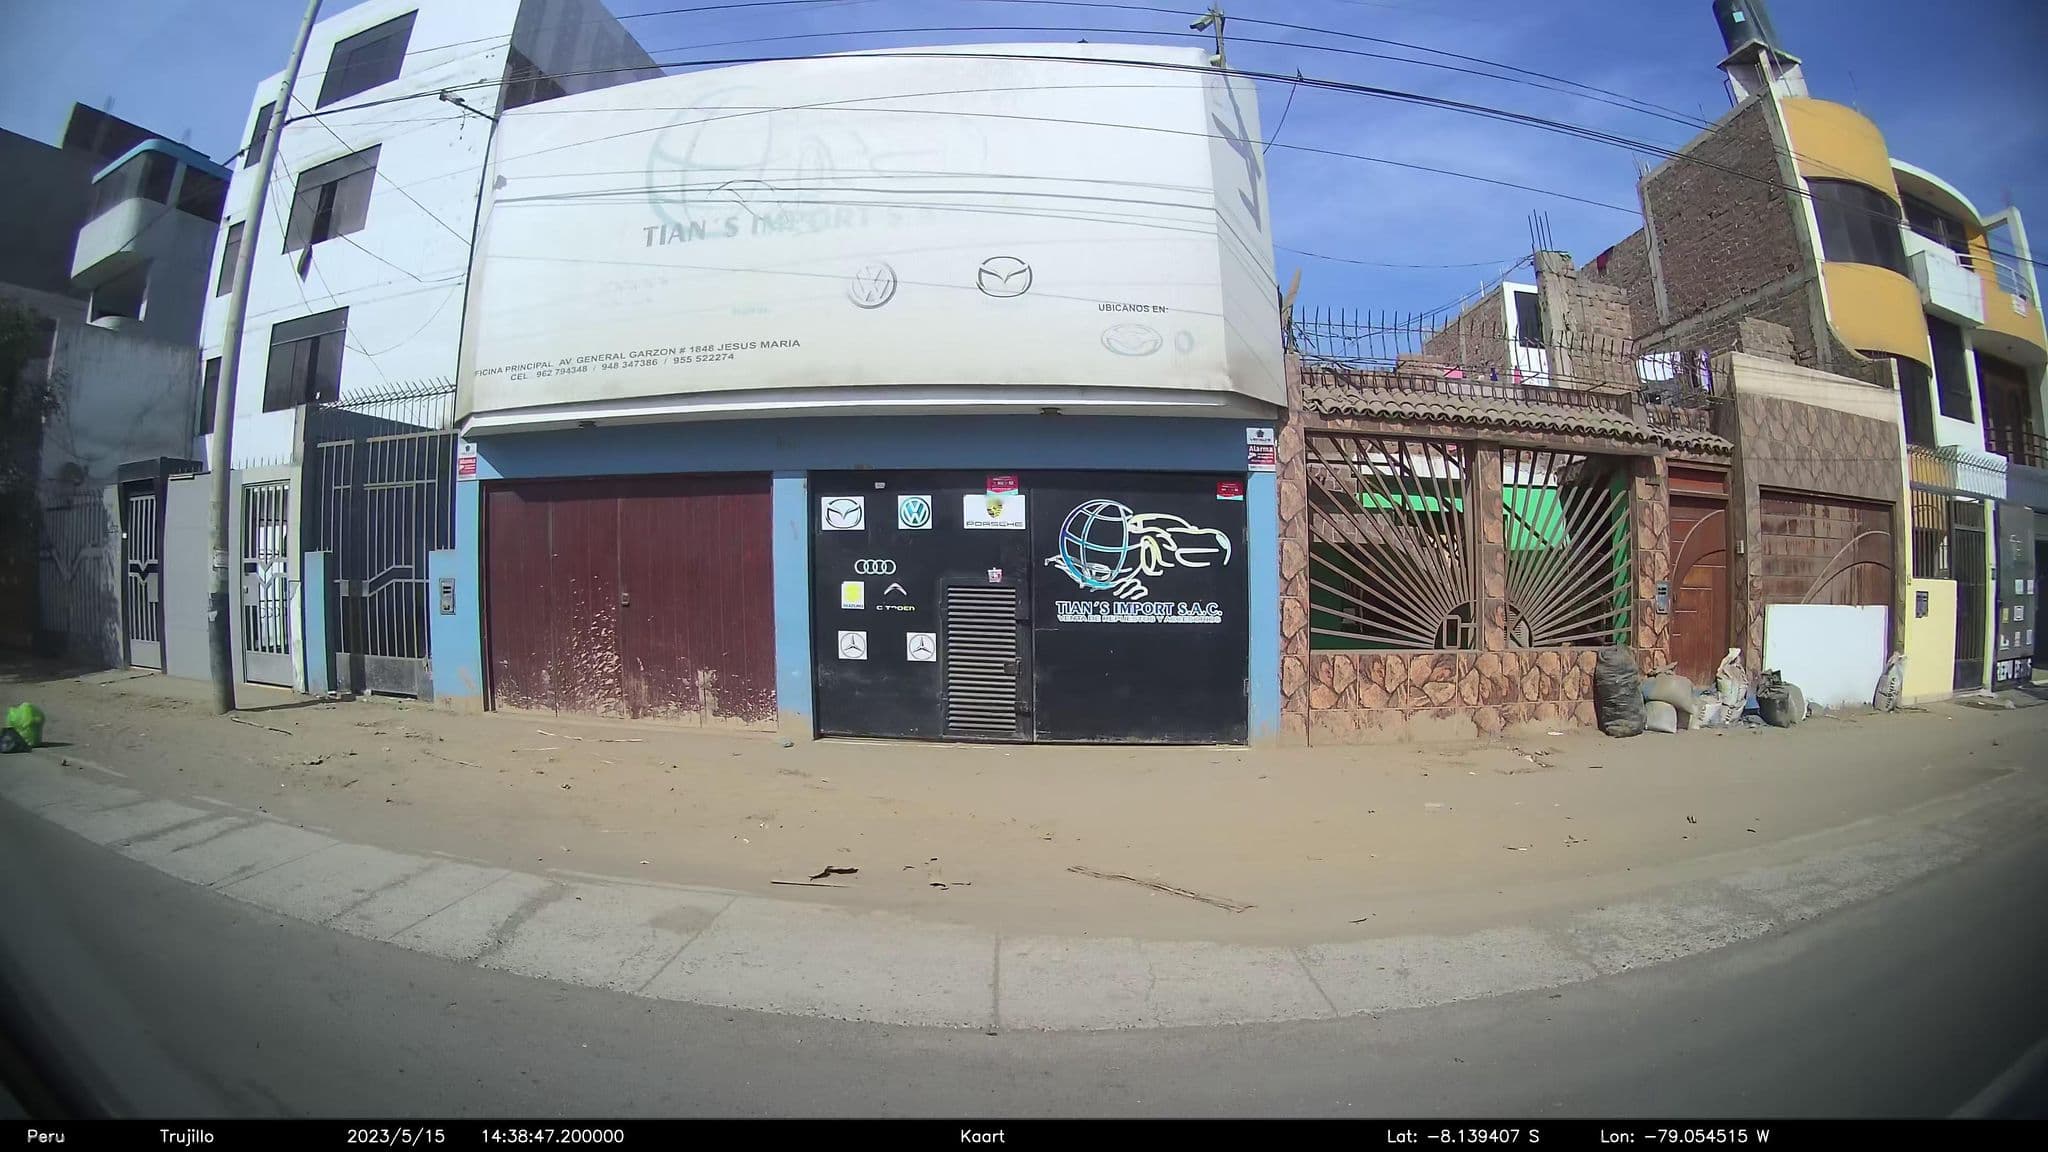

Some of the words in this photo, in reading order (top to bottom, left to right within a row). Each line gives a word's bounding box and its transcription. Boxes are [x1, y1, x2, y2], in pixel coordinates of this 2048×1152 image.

[1098, 303, 1150, 313] UBICANOS
[474, 366, 503, 377] FICINA
[505, 360, 552, 373] PRINCIPAL
[576, 352, 626, 364] GENERAL
[629, 347, 676, 359] GARZON
[717, 341, 757, 351] JESUS
[760, 339, 801, 349] MARIA
[673, 355, 693, 365] 955
[695, 353, 735, 363] 522274
[1113, 601, 1174, 615] IMPORT
[1177, 601, 1223, 616] S.A.C.
